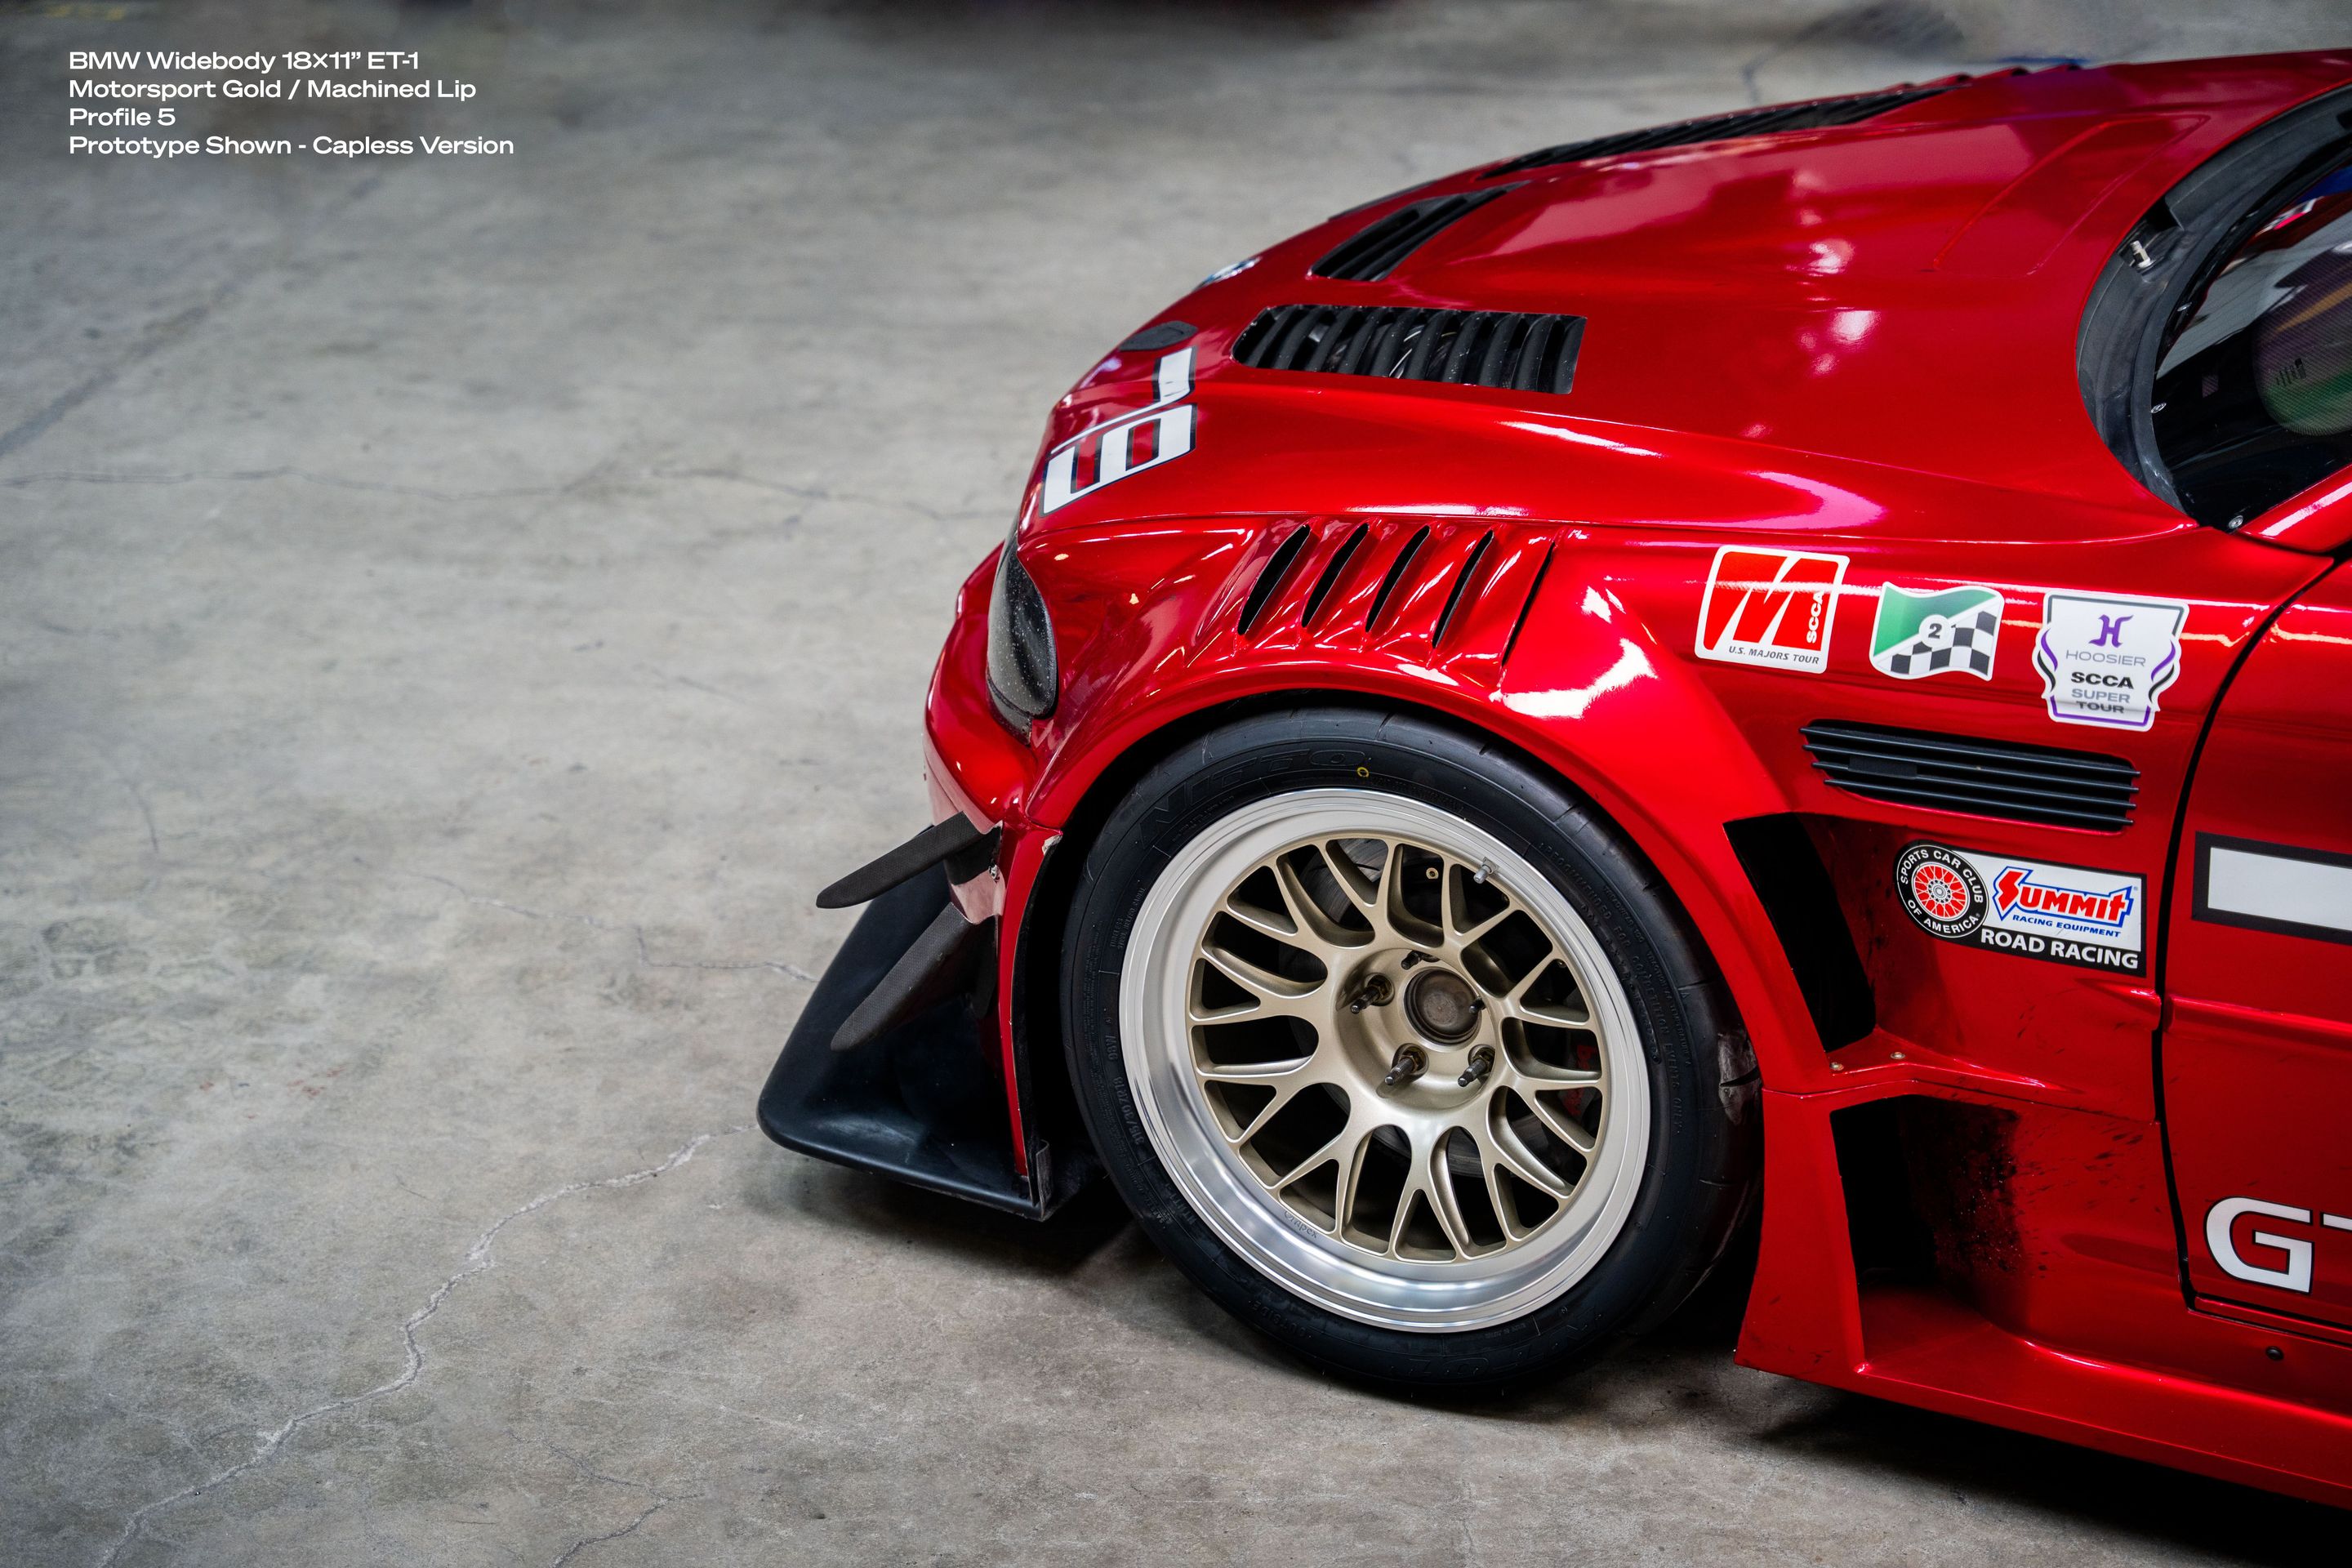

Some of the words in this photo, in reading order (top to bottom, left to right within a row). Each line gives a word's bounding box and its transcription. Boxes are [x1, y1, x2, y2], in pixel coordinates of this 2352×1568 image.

[1806, 590, 1824, 644] SCCA
[1928, 622, 1942, 639] 2
[1729, 645, 1746, 656] U.S.
[1748, 648, 1790, 661] MAJORS
[1793, 654, 1820, 665] TOUR
[2065, 649, 2147, 667] HOOSIER
[2070, 670, 2134, 689] SCCA
[2071, 688, 2131, 704] SUPER
[2075, 701, 2124, 715] TOUR
[1900, 849, 1929, 885] SPORTS
[1933, 850, 1962, 869] CAR
[1962, 868, 1984, 904] CLUB
[1907, 899, 1922, 915] OF
[1923, 915, 1980, 933] AMERICA
[2012, 914, 2053, 927] RACING
[2056, 921, 2122, 938] EQUIPMENT
[1980, 928, 2045, 953] ROAD
[2051, 940, 2139, 970] RACING
